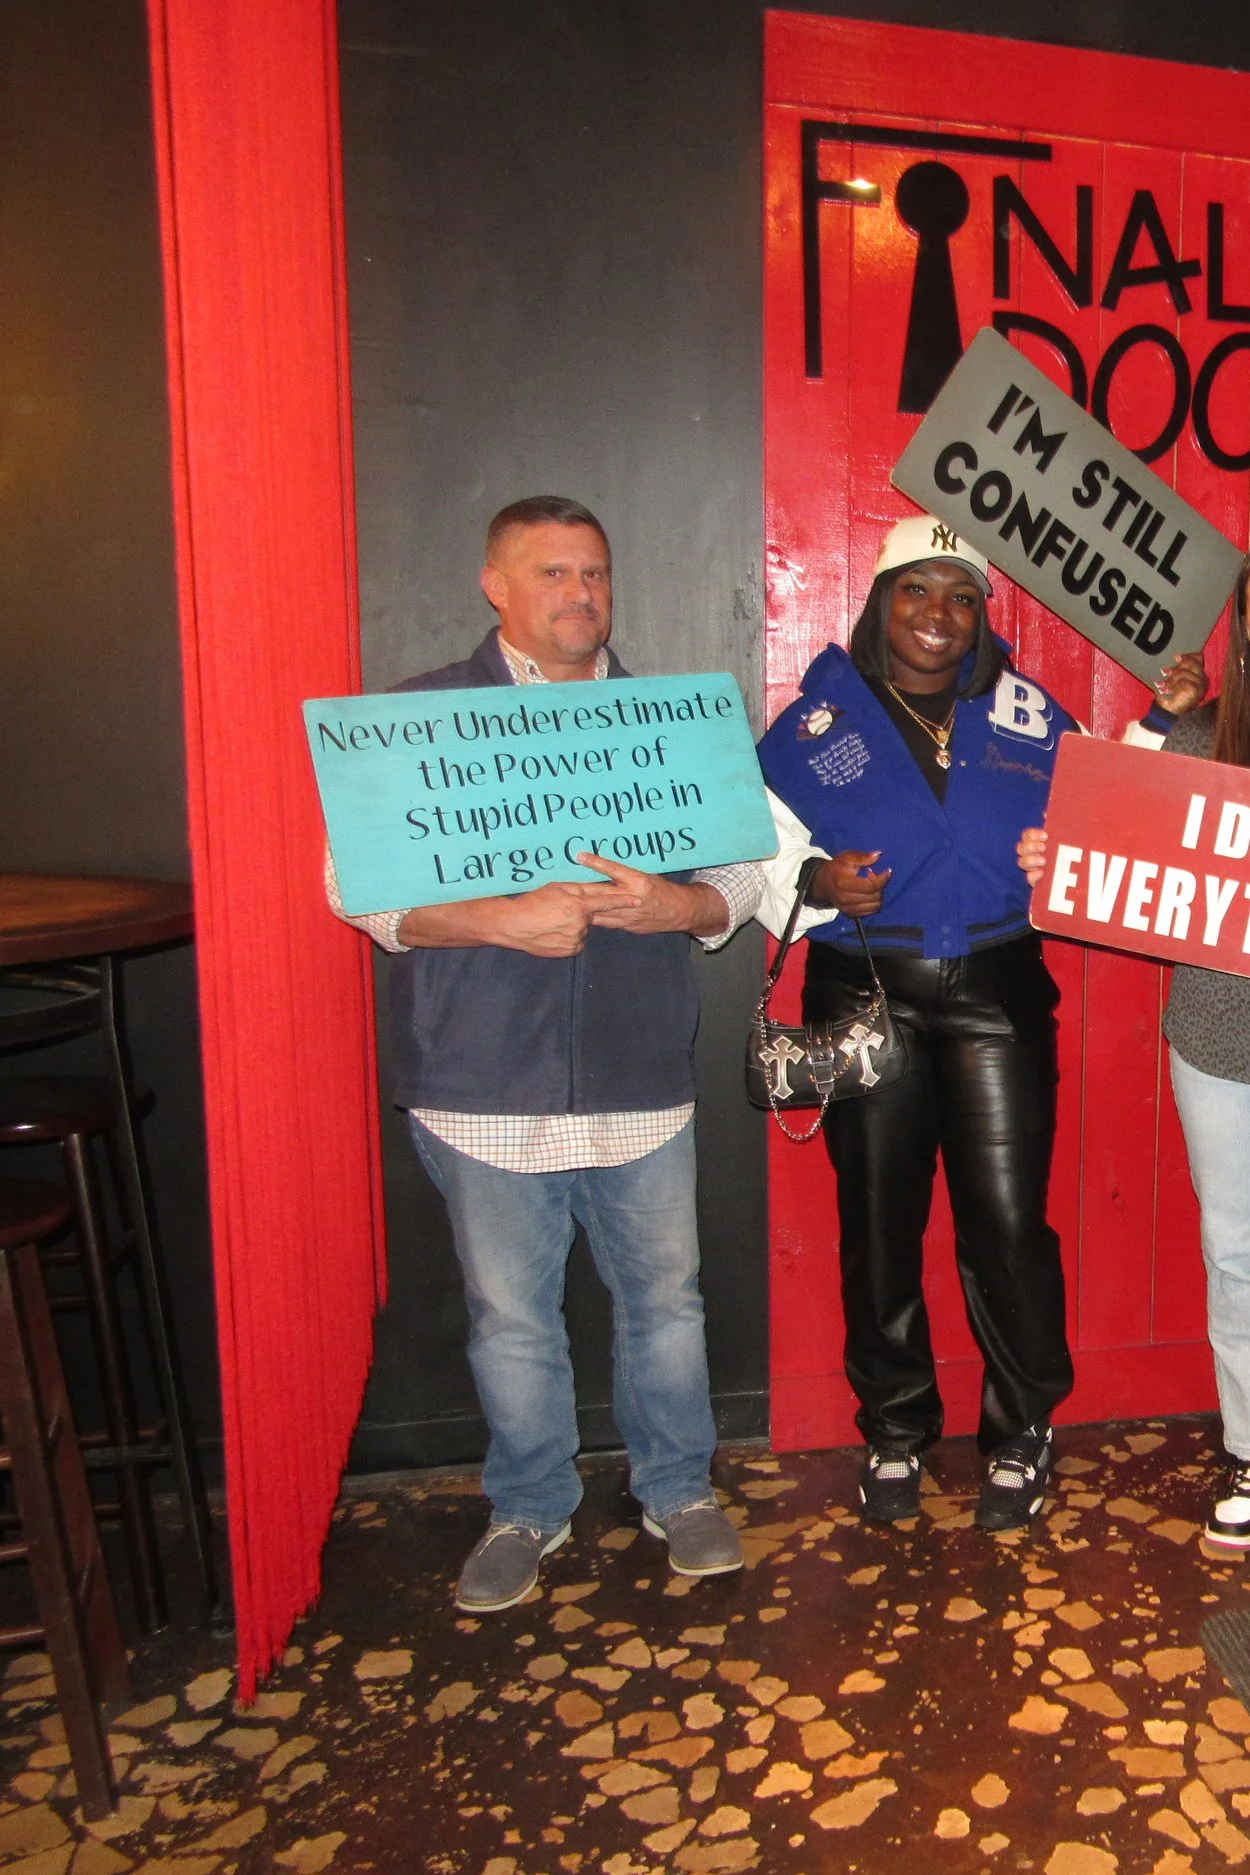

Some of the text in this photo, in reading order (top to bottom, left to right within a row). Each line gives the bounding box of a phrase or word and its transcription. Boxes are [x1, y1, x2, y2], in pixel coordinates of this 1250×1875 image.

[987, 384, 1188, 586] I'M STILL
[931, 524, 958, 553] NY
[934, 441, 1174, 657] CONFUSED
[317, 691, 733, 753] Never Underestimate
[988, 670, 1053, 748] B
[418, 735, 669, 791] the Power of
[406, 779, 704, 841] Stupid People in
[1181, 794, 1206, 850] I
[433, 825, 698, 885] Large Groups
